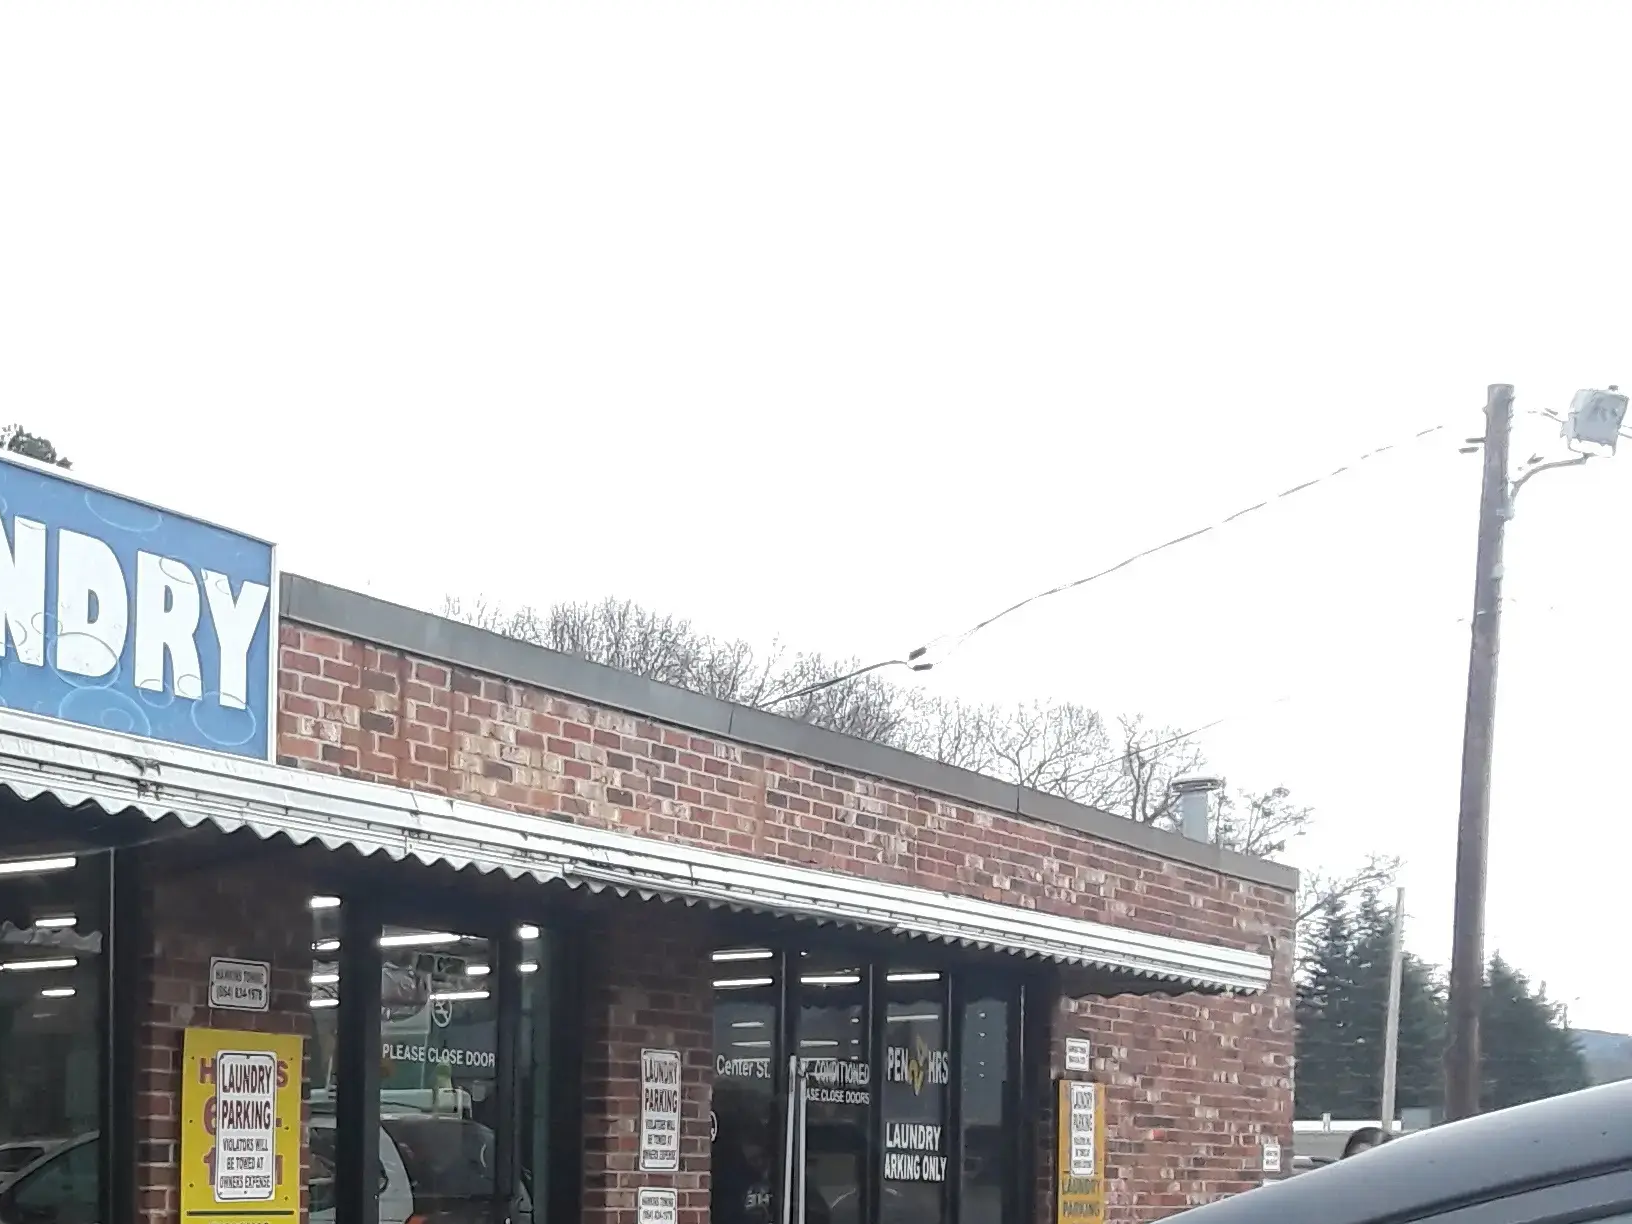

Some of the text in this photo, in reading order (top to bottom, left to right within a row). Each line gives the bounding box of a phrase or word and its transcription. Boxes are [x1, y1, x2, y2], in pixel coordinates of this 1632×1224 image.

[382, 1043, 495, 1067] PLEASE CLOSE DOOR
[716, 1055, 753, 1076] Center
[928, 1050, 948, 1084] HRS
[221, 1063, 272, 1094] LAUNDRY
[644, 1088, 678, 1113] PARKING
[821, 1088, 845, 1103] CLOSE
[846, 1091, 870, 1104] DOORS
[221, 1099, 271, 1130] PARKING
[886, 1121, 941, 1152] LAUNDRY
[884, 1153, 947, 1182] ARKING ONLY
